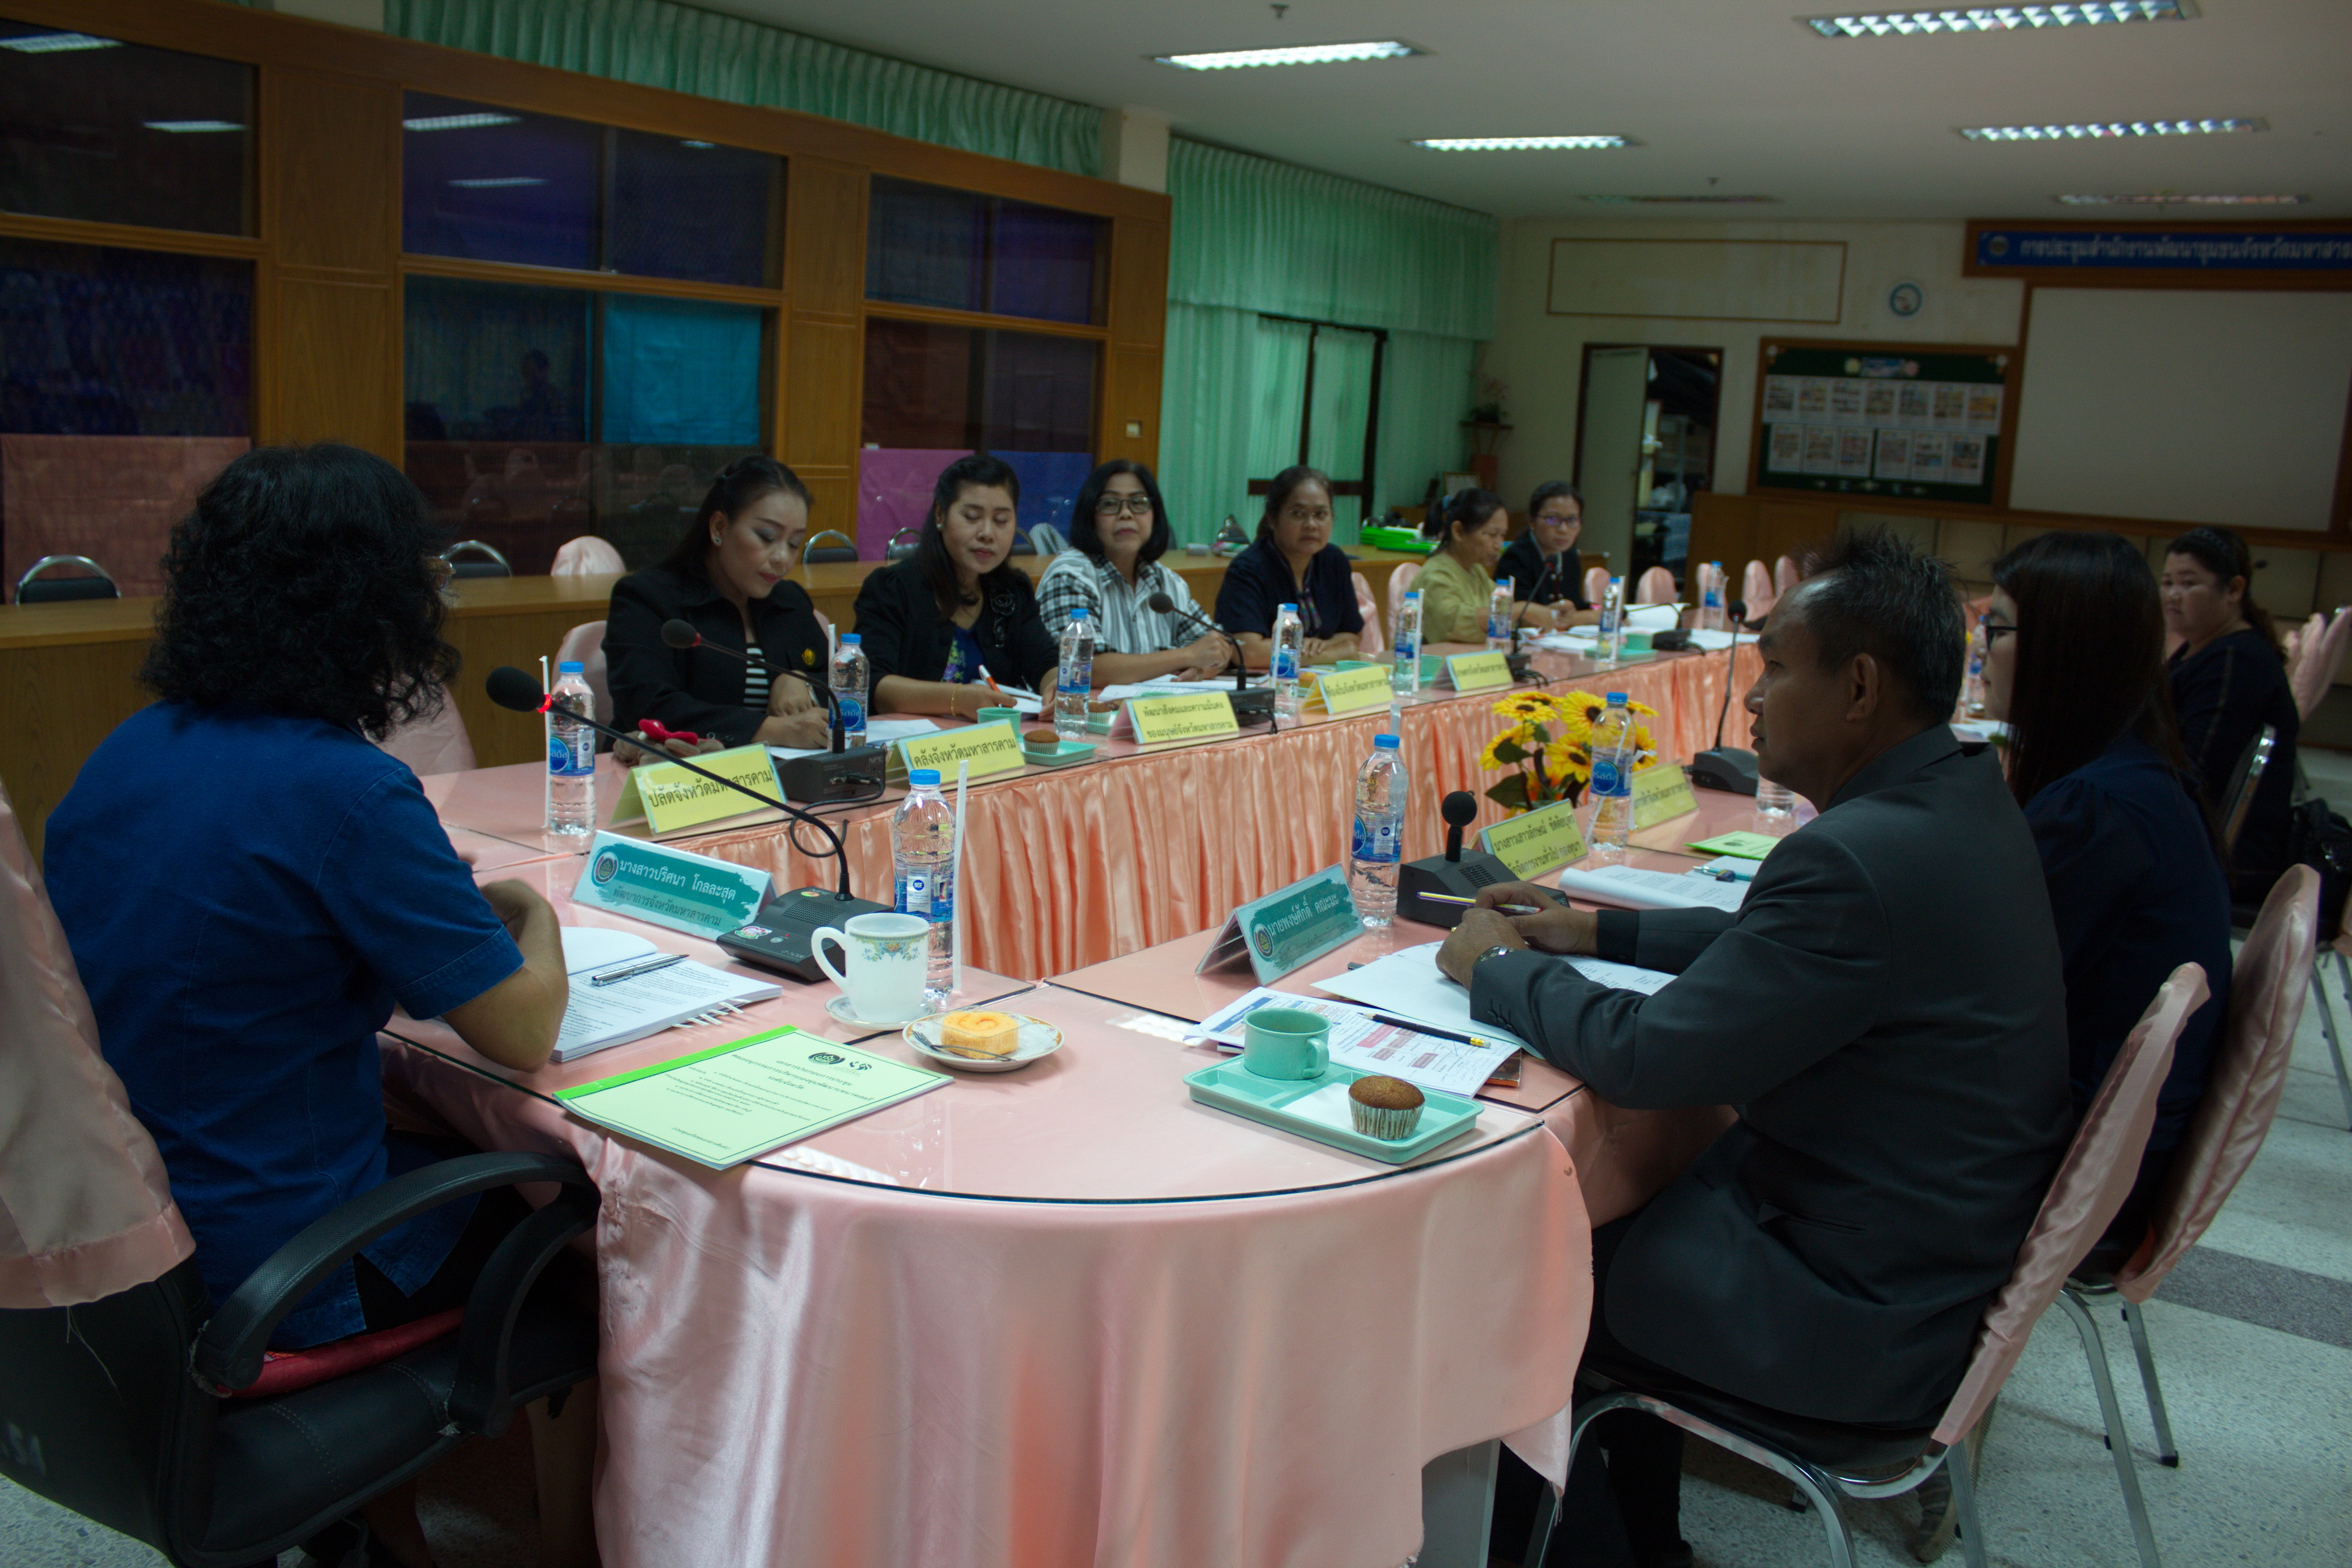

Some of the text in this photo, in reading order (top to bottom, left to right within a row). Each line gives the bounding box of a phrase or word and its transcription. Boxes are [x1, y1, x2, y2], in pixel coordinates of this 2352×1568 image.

[914, 737, 1017, 768] คลังจังหวัดมหาสารคาม
[648, 769, 773, 808] ปลัดจังหวัดมหสารคาม
[619, 859, 736, 905] นางสาวปริศนา โกลละสุต
[613, 886, 722, 926] พัฒนาการจังหวัดมหาสารคาม
[1268, 893, 1339, 936] นายพงษ์ศักดิ์ คณะมะ
